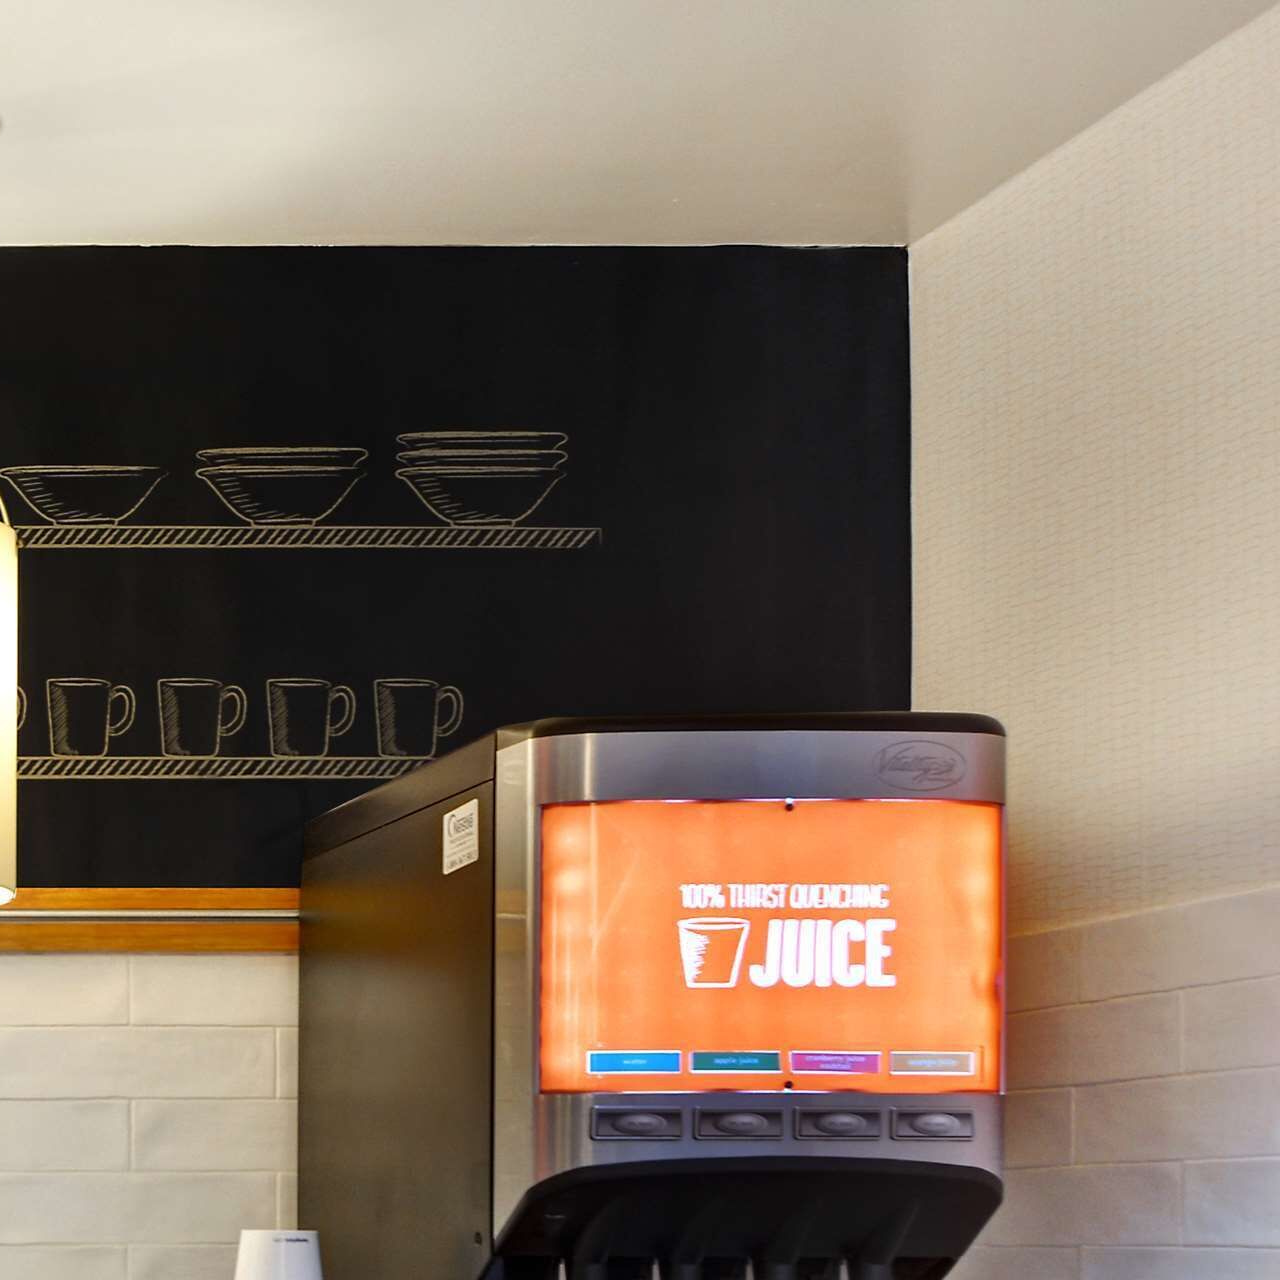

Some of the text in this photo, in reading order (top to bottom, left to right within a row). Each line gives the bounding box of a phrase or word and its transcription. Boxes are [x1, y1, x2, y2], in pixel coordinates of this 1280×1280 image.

[679, 884, 890, 909] 100% THIRST QUENCHING
[748, 918, 896, 988] JUICE
